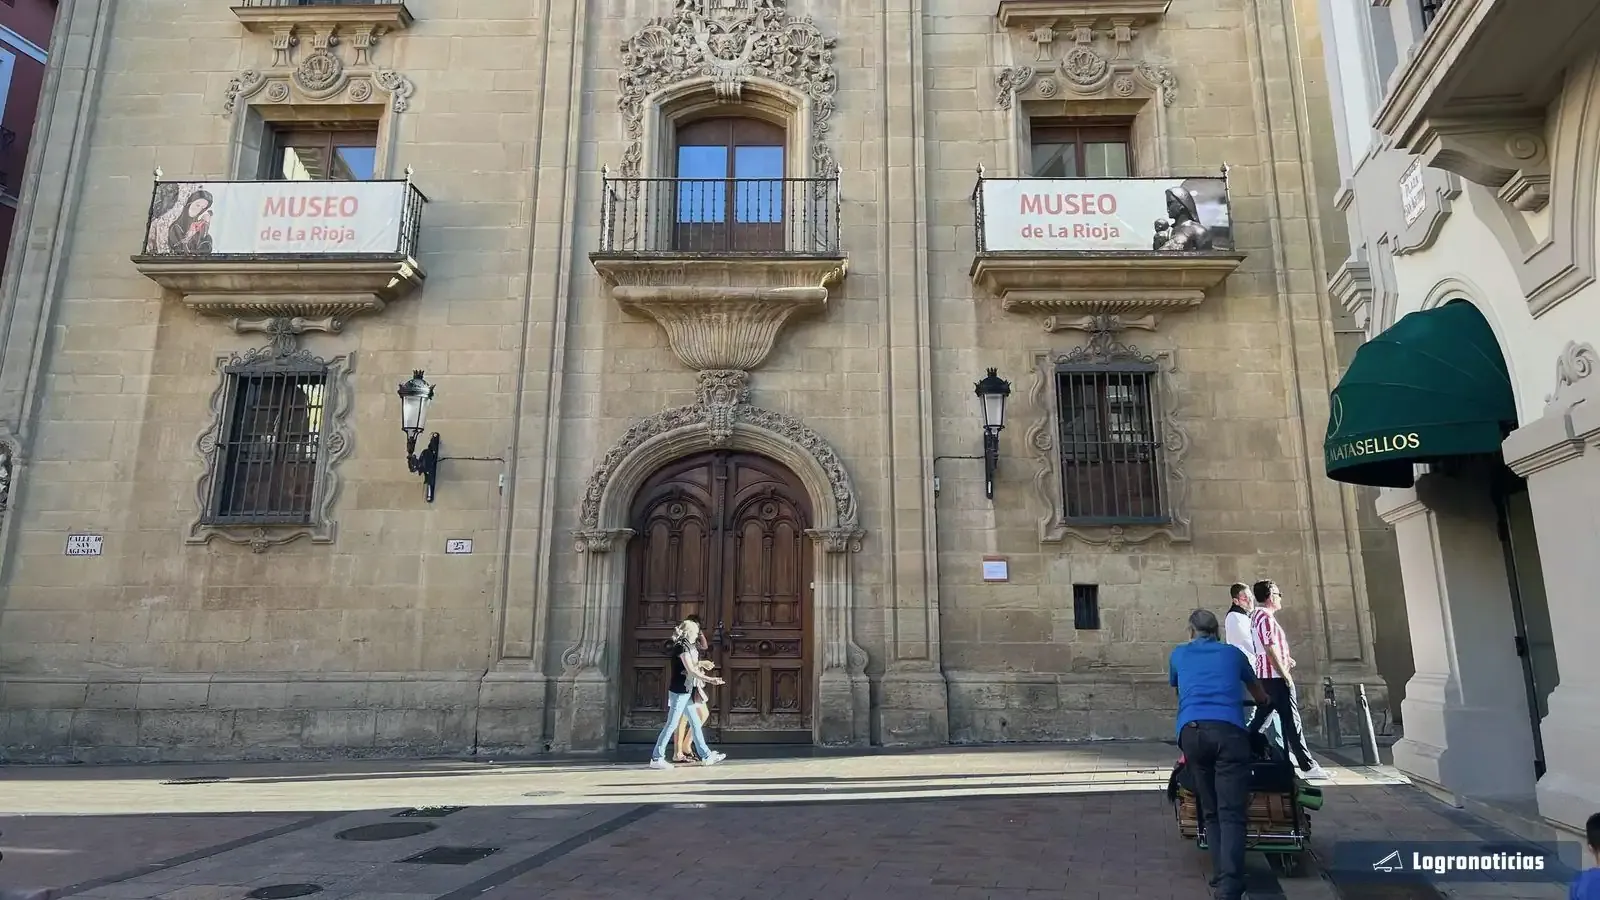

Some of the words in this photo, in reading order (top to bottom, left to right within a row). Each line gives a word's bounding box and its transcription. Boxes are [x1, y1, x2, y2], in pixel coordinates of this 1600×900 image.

[262, 196, 359, 218] MUSEO
[1020, 193, 1118, 215] MUSEO
[260, 226, 282, 241] de
[286, 226, 306, 242] La
[310, 225, 355, 244] Rioja
[1021, 223, 1044, 238] de
[1048, 223, 1068, 238] La
[1073, 222, 1120, 240] Rioja
[1329, 432, 1420, 462] MATASELLOS
